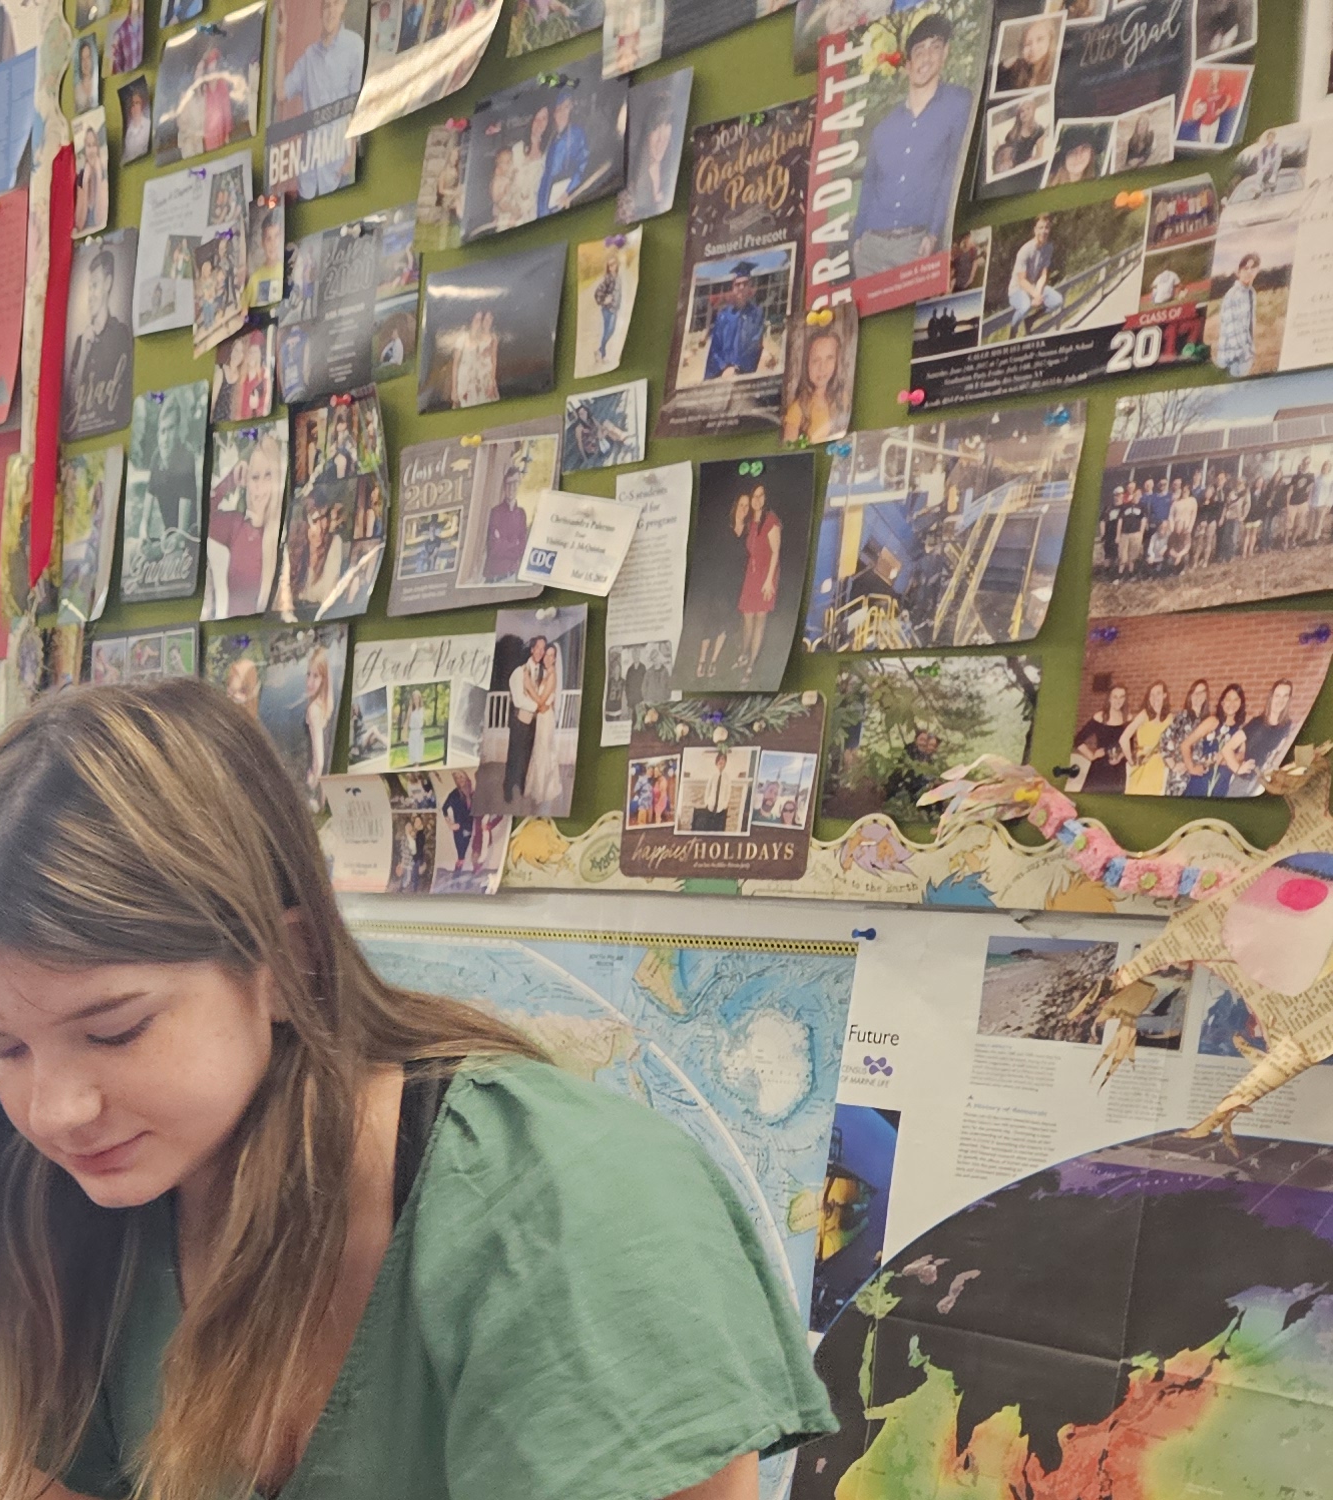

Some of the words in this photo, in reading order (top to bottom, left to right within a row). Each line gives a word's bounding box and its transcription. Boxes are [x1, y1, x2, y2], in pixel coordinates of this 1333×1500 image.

[269, 116, 352, 186] BENJAMIN
[724, 164, 790, 211] Party
[1139, 310, 1166, 325] CLASS
[1168, 307, 1182, 320] OF
[404, 476, 464, 511] 2021
[531, 550, 556, 568] CDC
[694, 841, 795, 862] HOLIDAYS
[848, 1025, 900, 1046] Future
